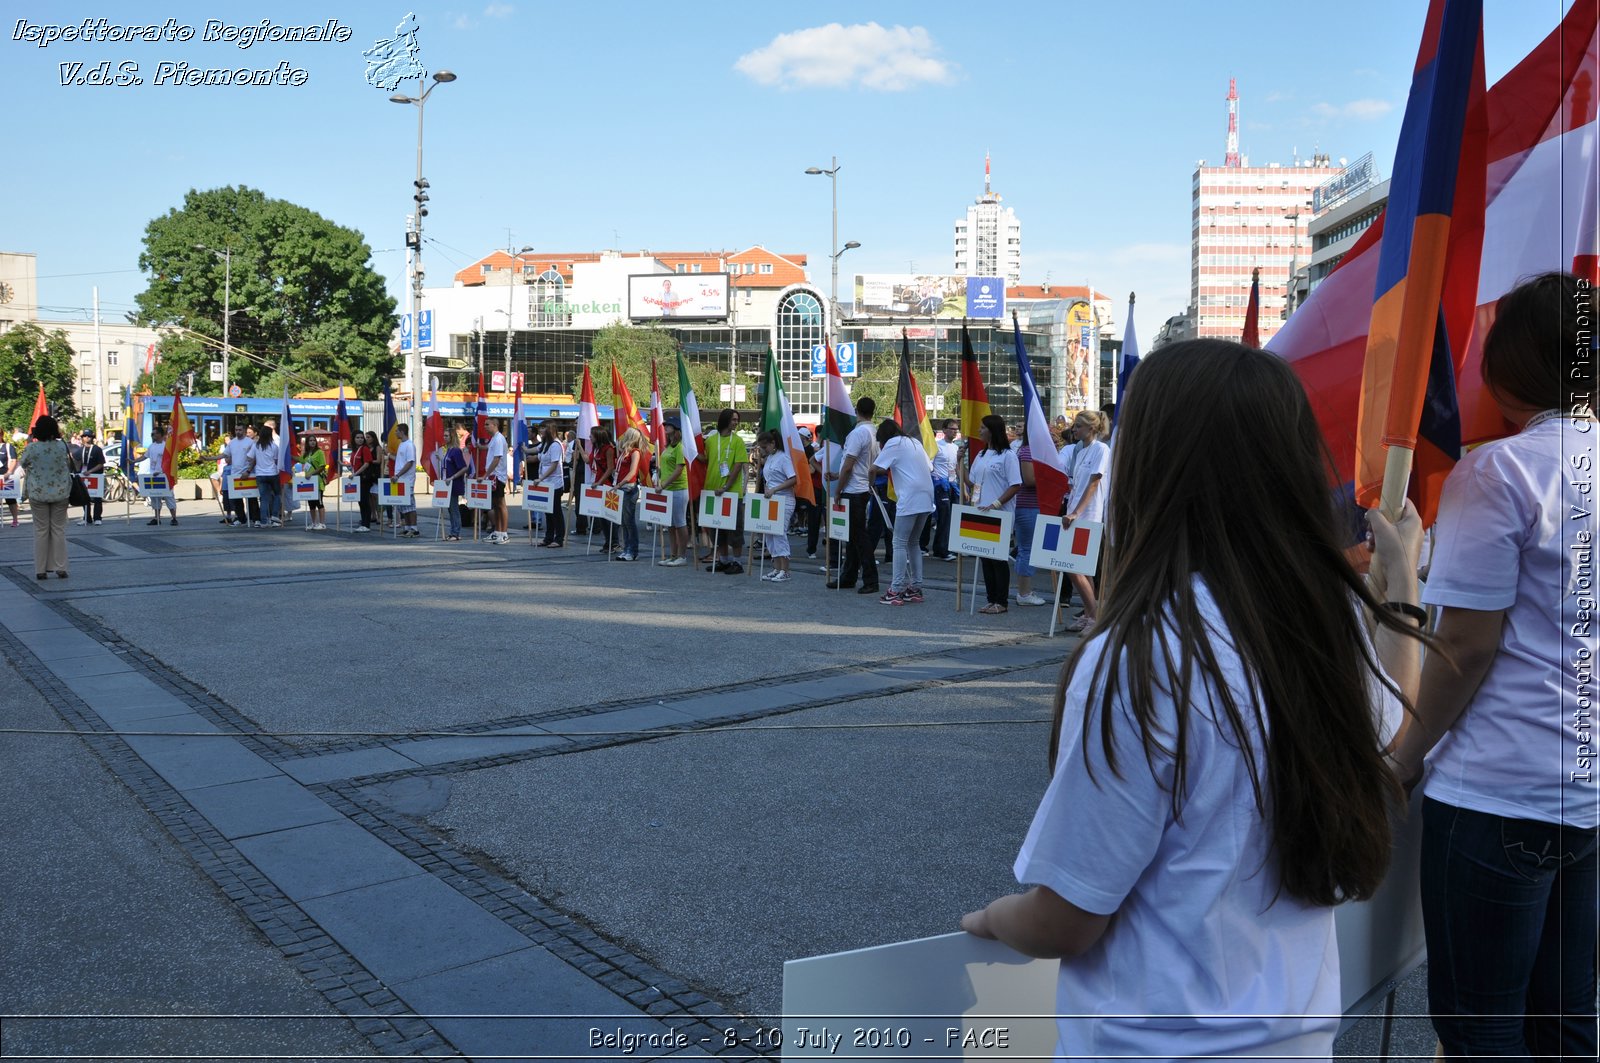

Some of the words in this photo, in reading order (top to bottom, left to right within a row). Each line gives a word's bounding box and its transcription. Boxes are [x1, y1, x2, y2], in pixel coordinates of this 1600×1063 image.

[544, 300, 622, 314] Heineken
[755, 523, 772, 531] Ireland
[961, 542, 992, 556] Germany
[1050, 557, 1075, 569] France
